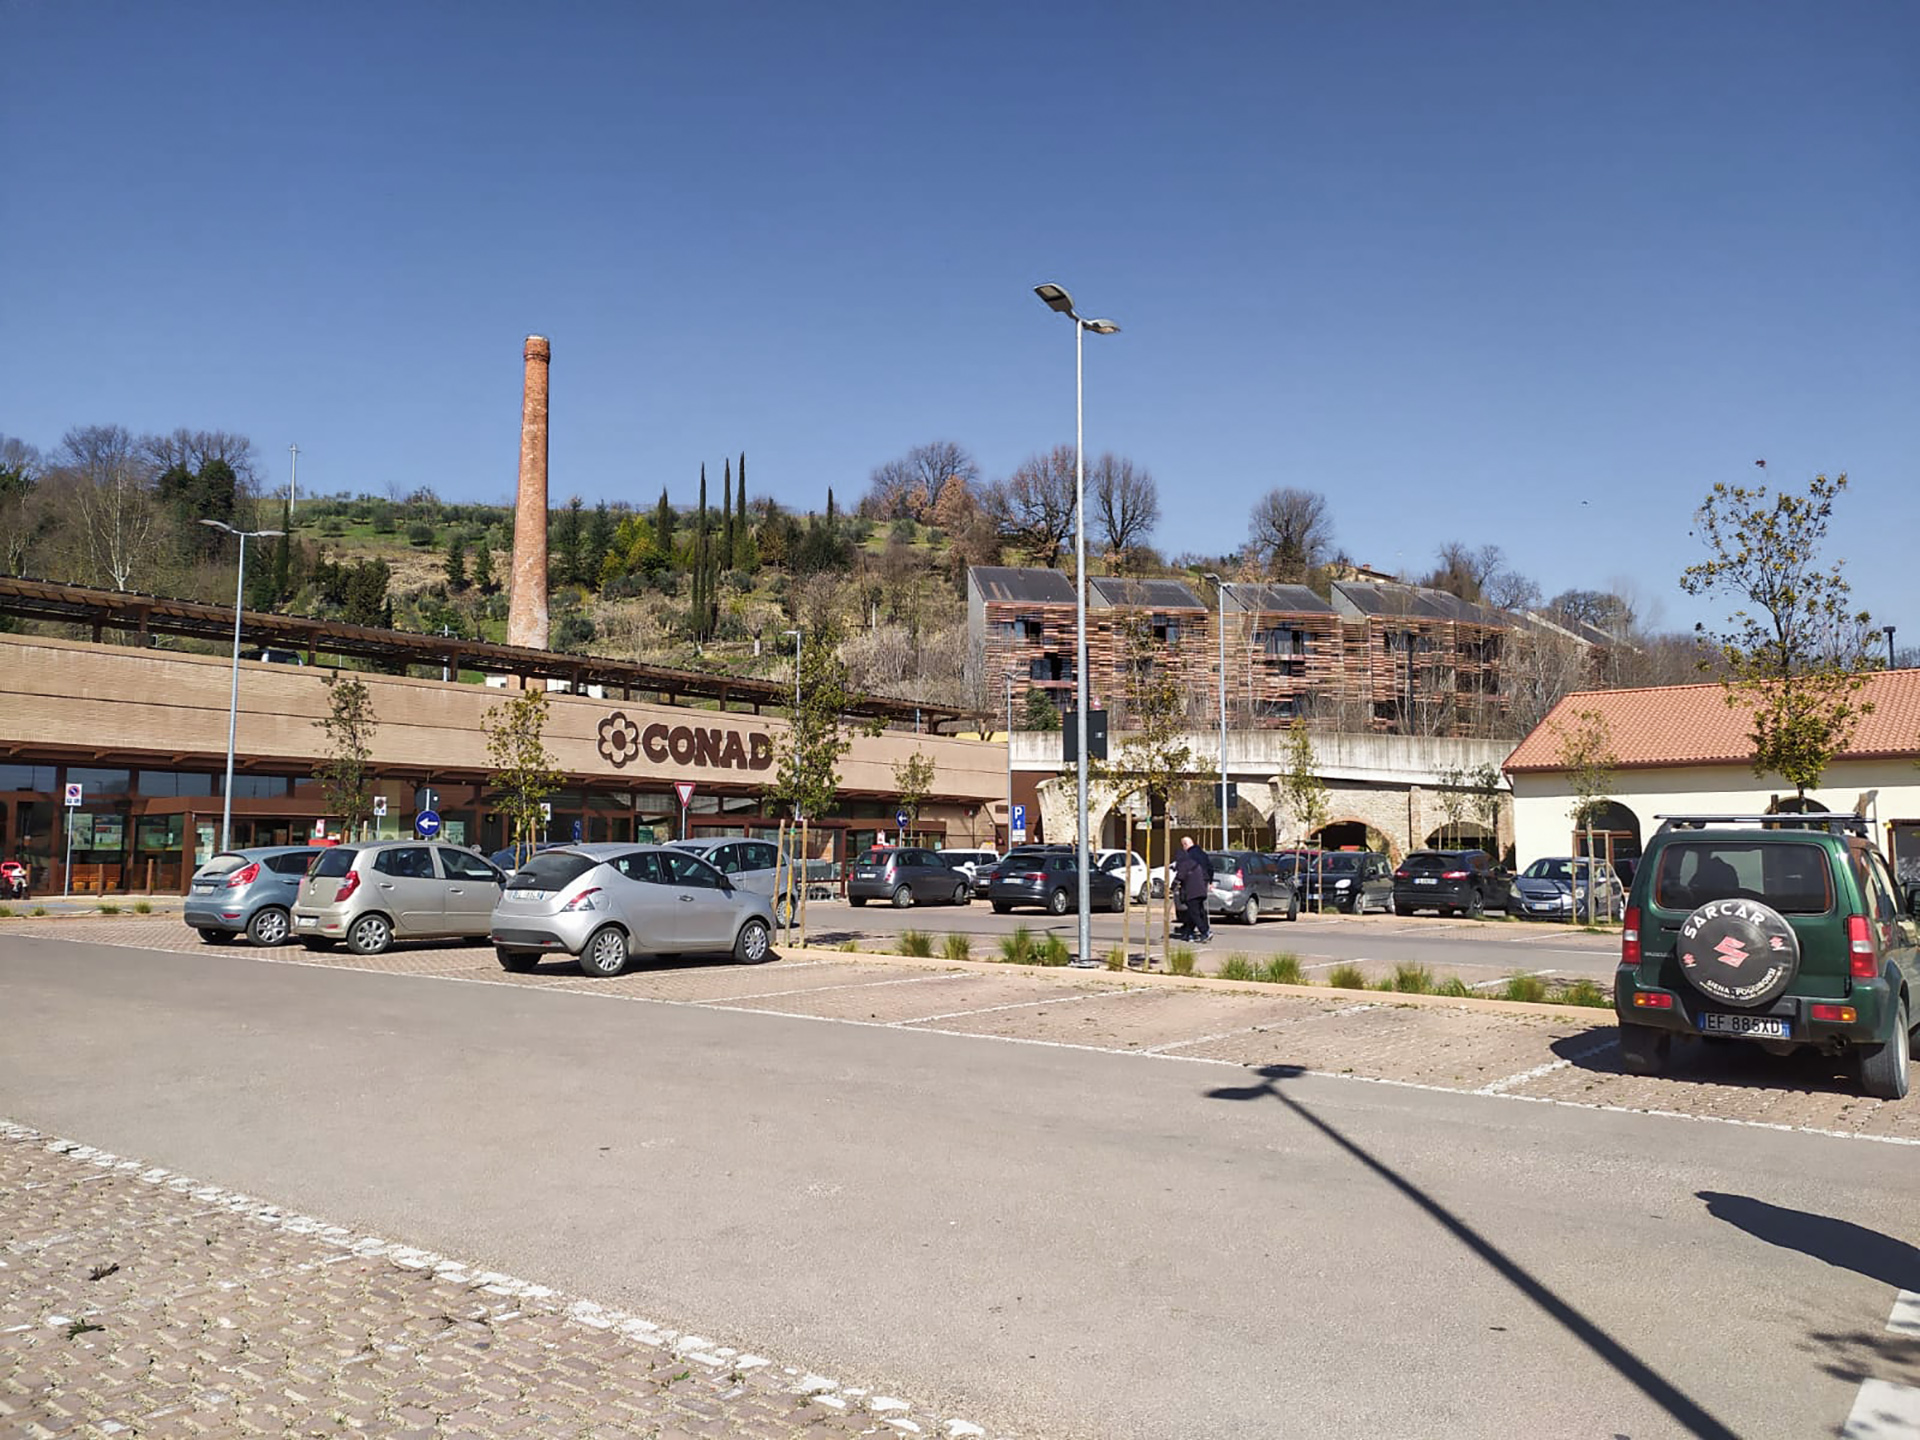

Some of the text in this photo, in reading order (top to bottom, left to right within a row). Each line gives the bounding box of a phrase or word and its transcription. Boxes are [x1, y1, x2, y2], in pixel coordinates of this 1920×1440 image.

[642, 723, 774, 771] CONAD
[1014, 806, 1023, 820] P
[1684, 903, 1765, 939] SARCAR
[1706, 980, 1730, 995] SIENA
[1707, 1014, 1780, 1034] EF 885XD
